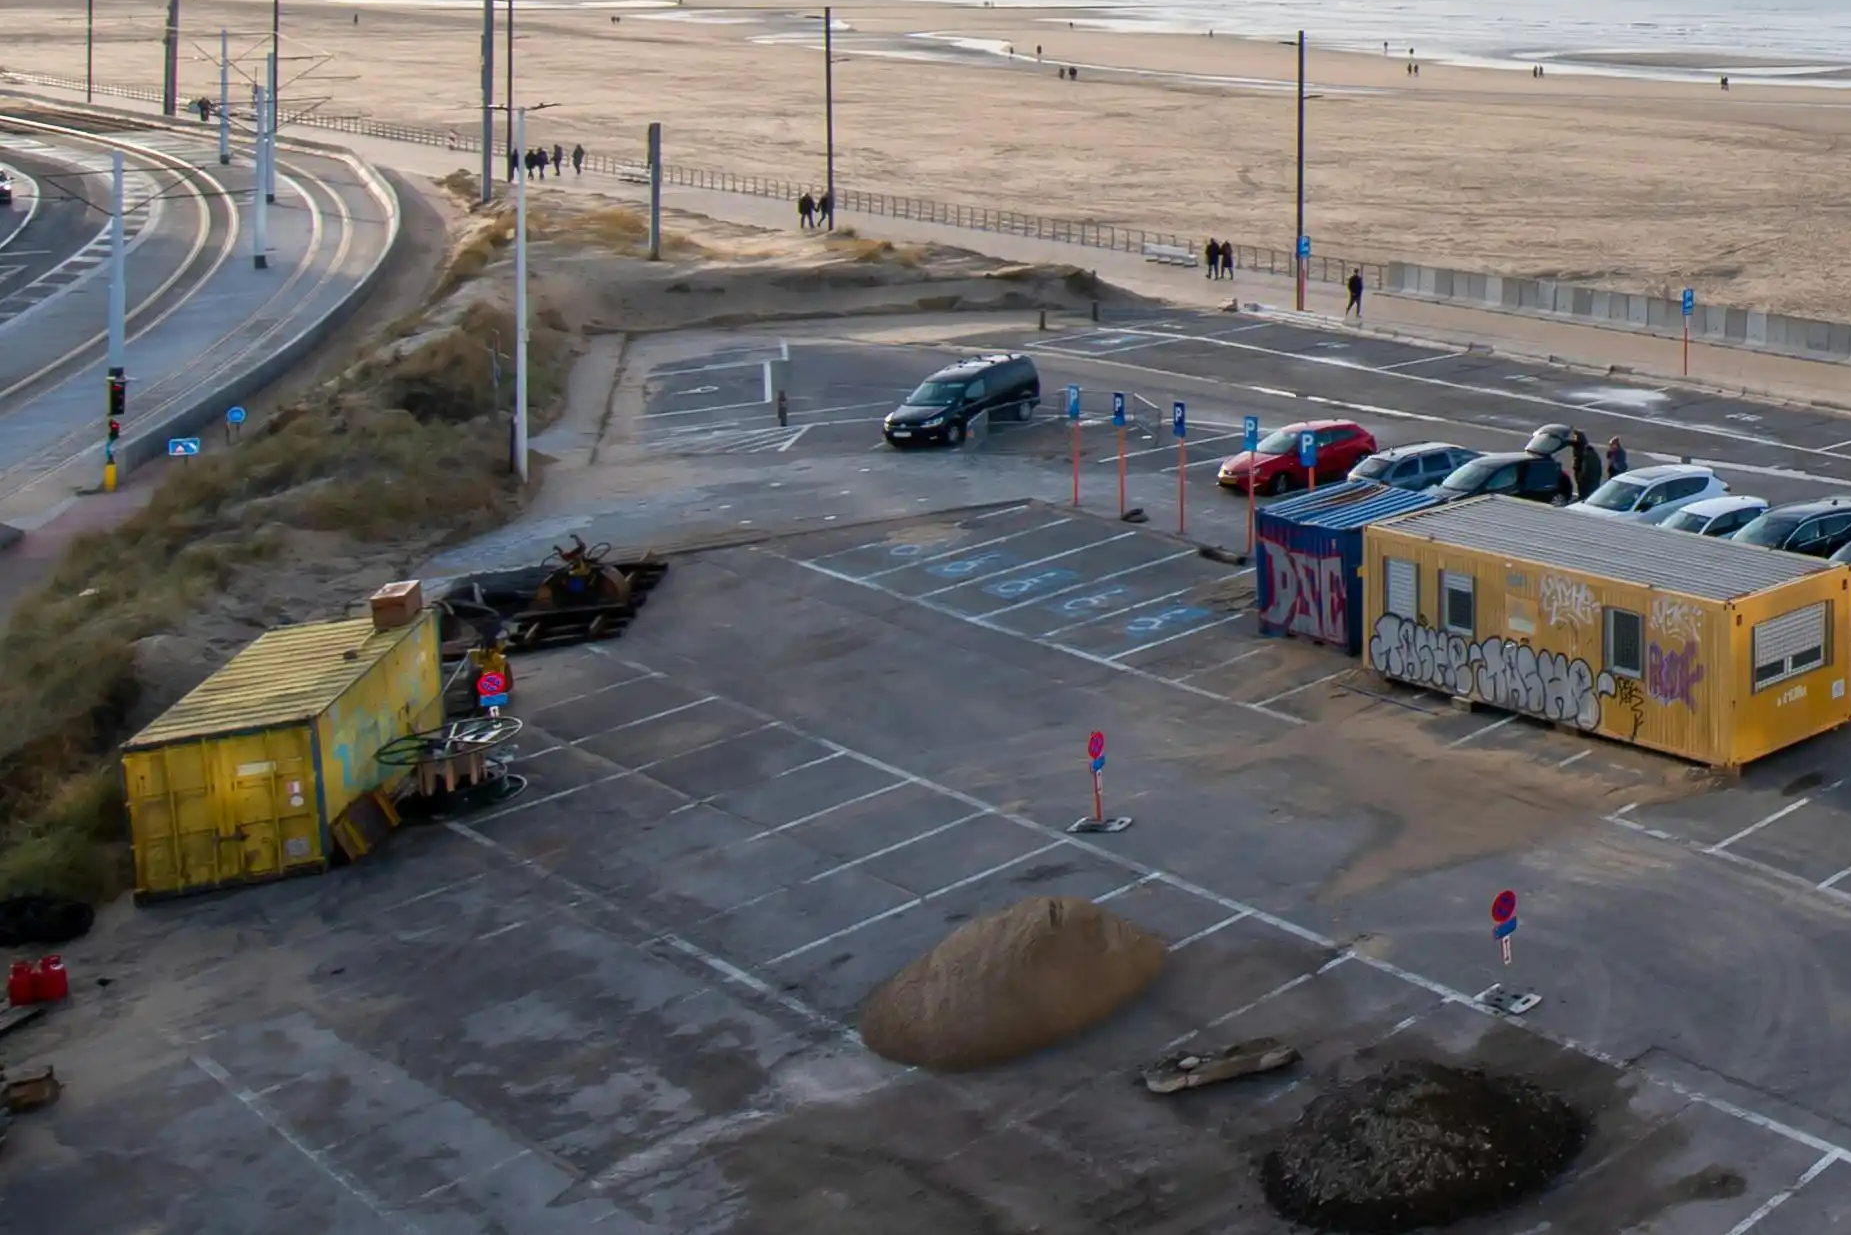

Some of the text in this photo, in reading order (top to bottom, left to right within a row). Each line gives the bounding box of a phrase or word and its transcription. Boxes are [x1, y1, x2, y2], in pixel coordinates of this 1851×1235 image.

[1070, 388, 1078, 405] P
[1114, 397, 1122, 411] P
[1175, 406, 1182, 422] P
[1245, 419, 1255, 438] P
[1301, 433, 1314, 454] P
